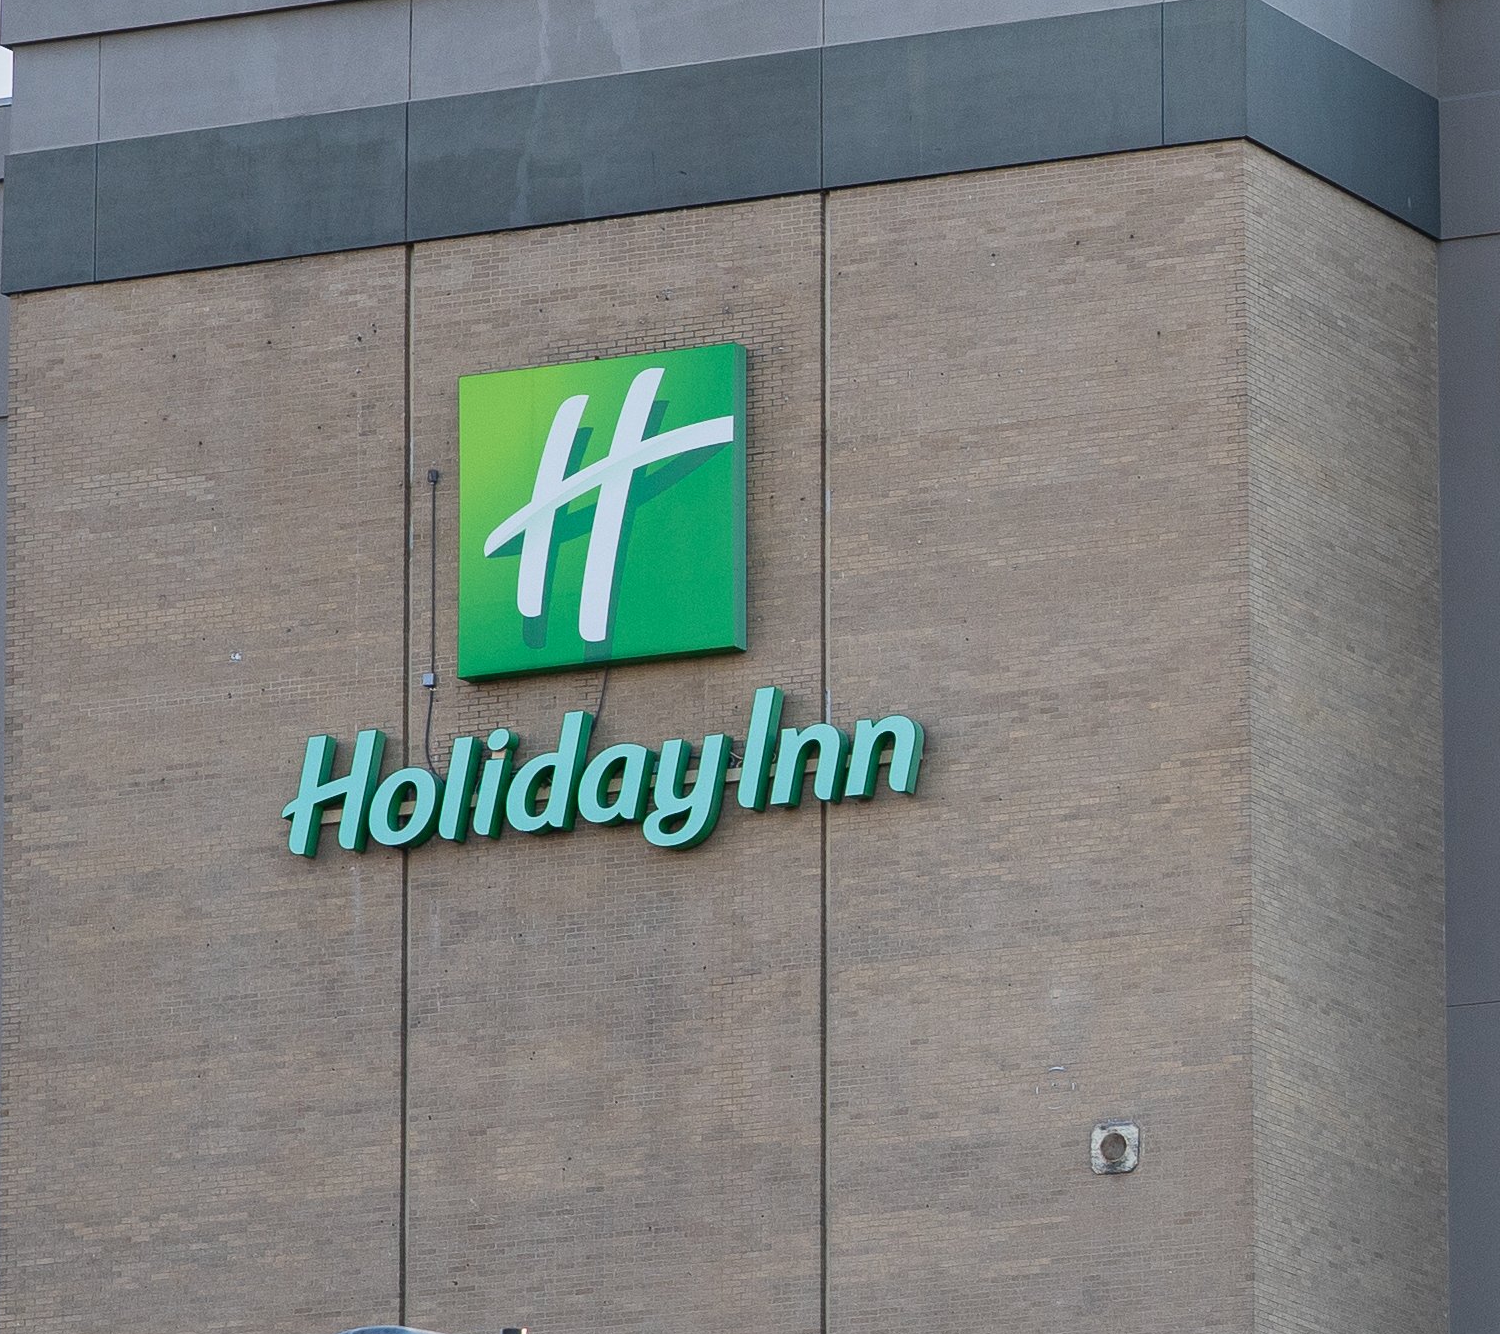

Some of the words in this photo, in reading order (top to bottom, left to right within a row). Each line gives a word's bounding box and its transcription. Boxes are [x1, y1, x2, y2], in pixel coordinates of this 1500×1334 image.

[483, 367, 734, 642] H
[281, 710, 733, 858] Holiday
[737, 686, 925, 812] Inn
